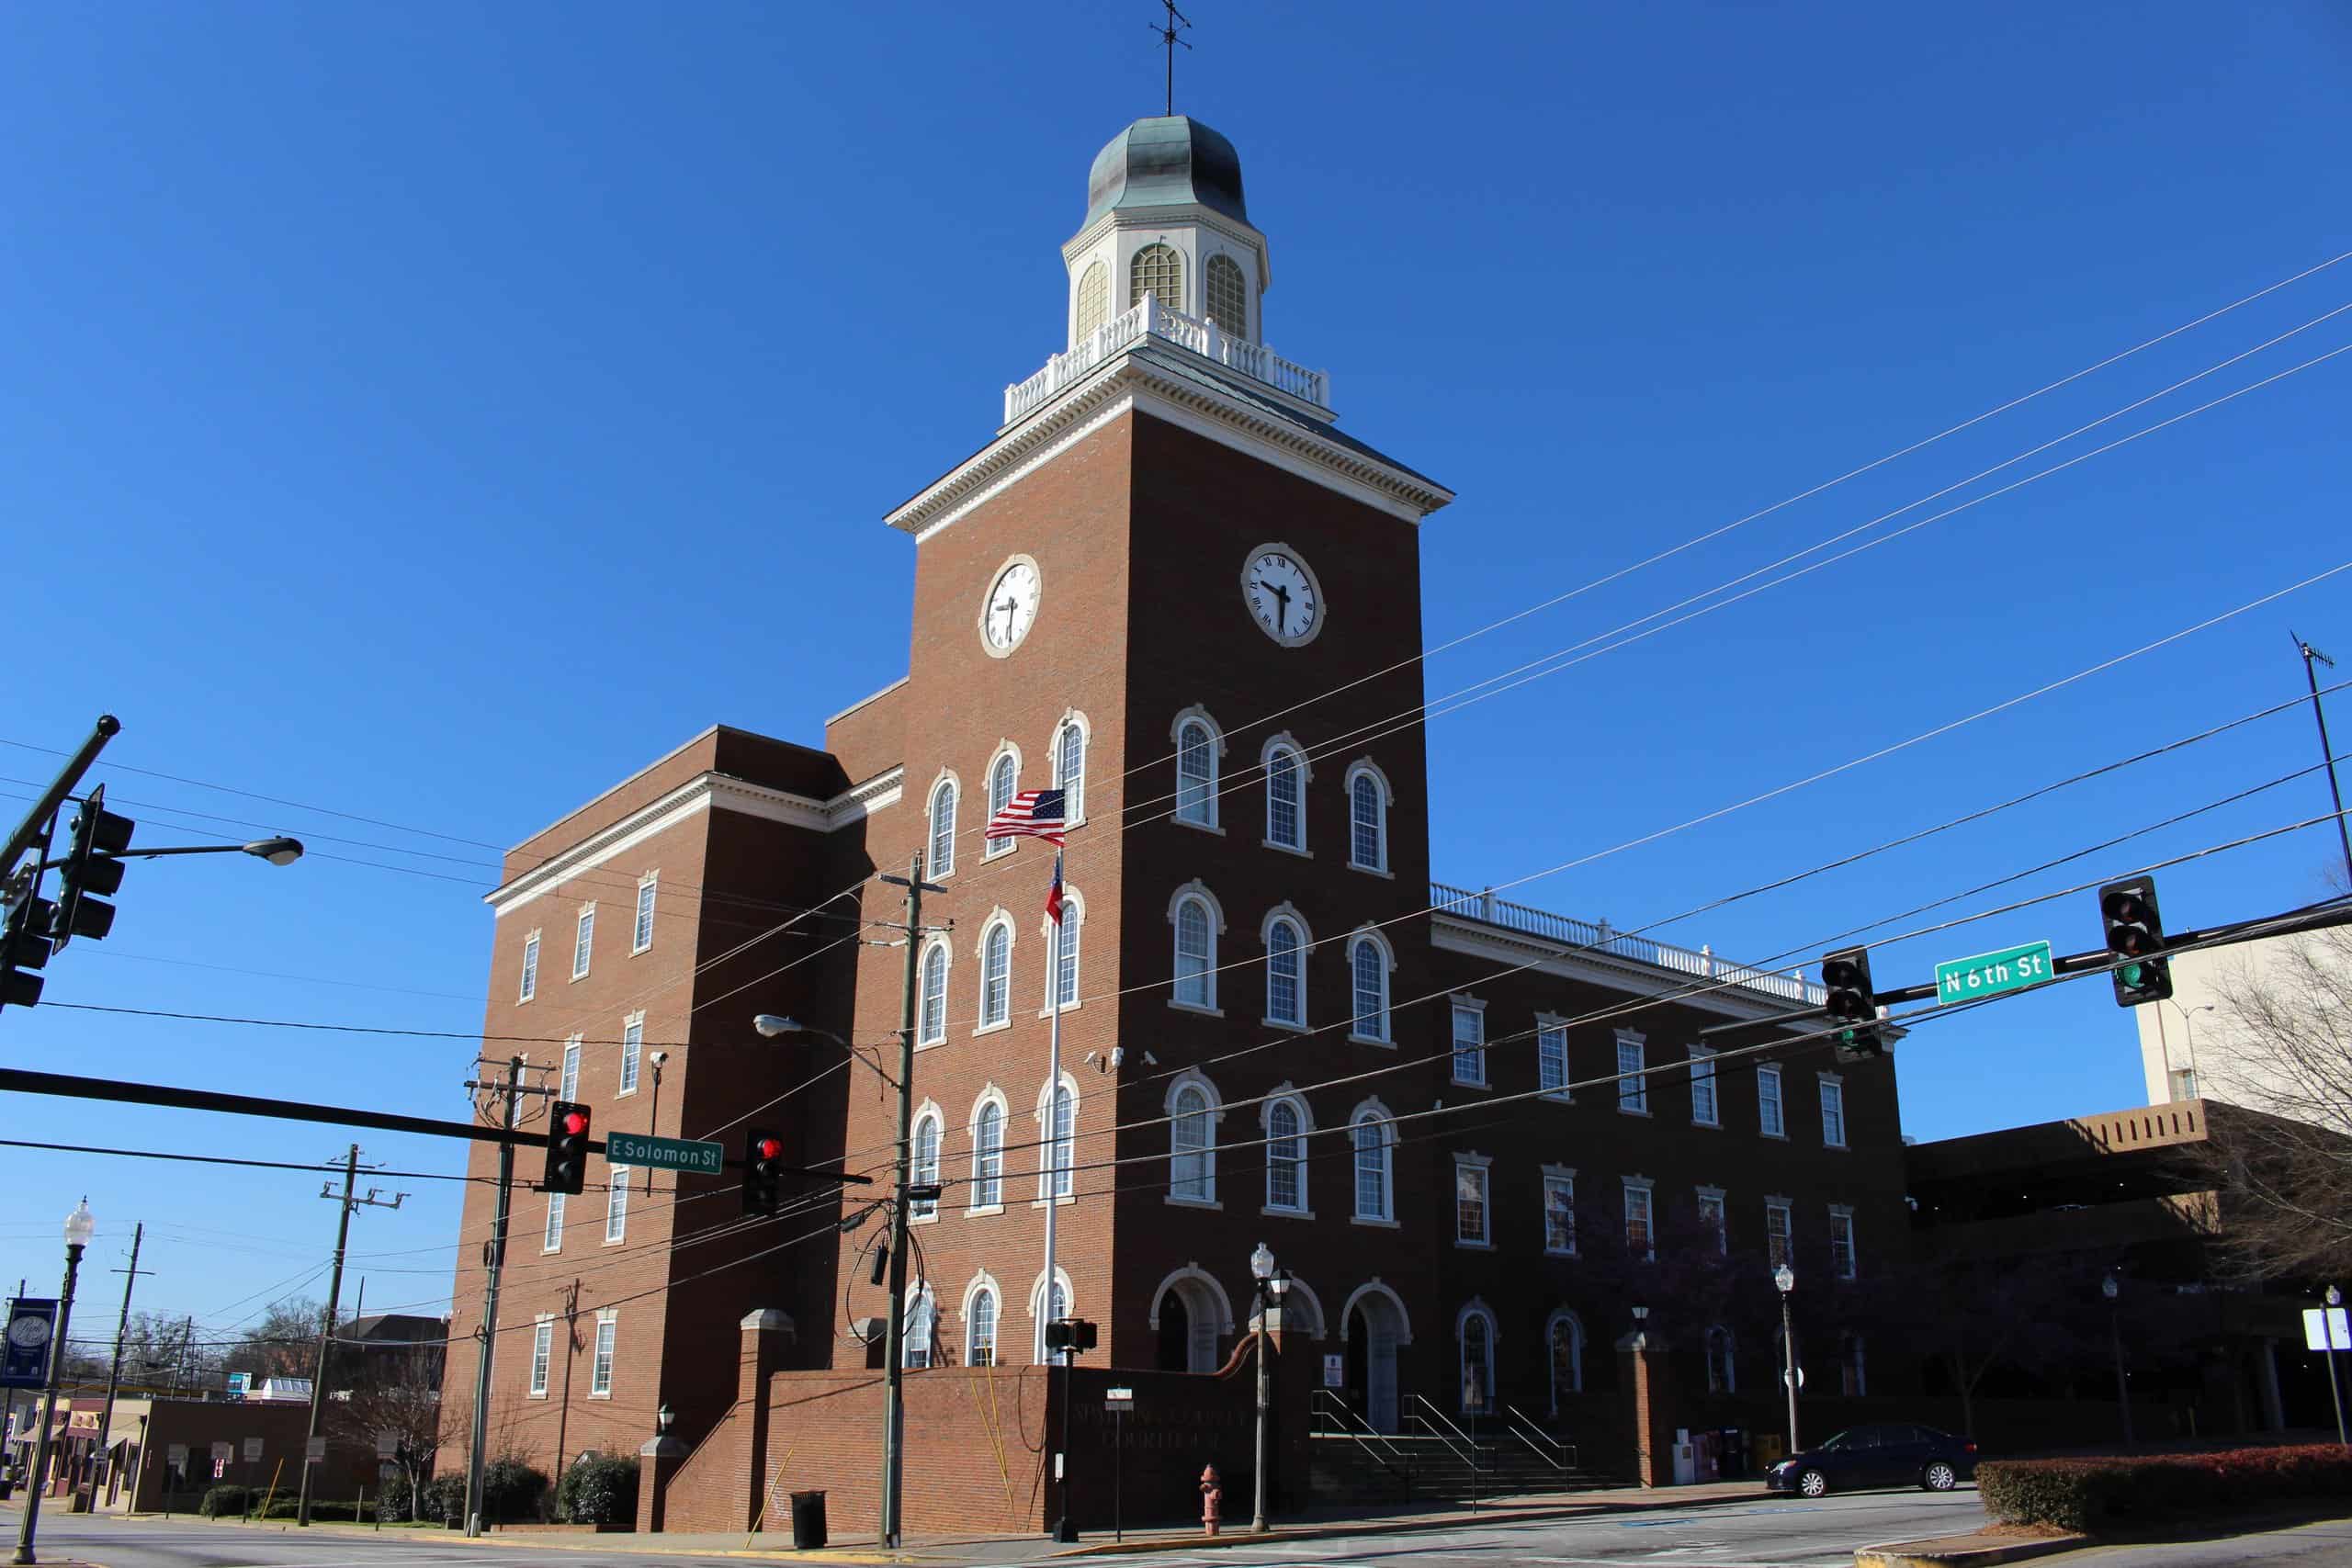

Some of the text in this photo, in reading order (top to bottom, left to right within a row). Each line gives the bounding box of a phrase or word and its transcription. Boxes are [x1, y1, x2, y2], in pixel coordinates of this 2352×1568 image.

[1945, 954, 2042, 993] N 6th St
[612, 1140, 717, 1167] E Solomon St
